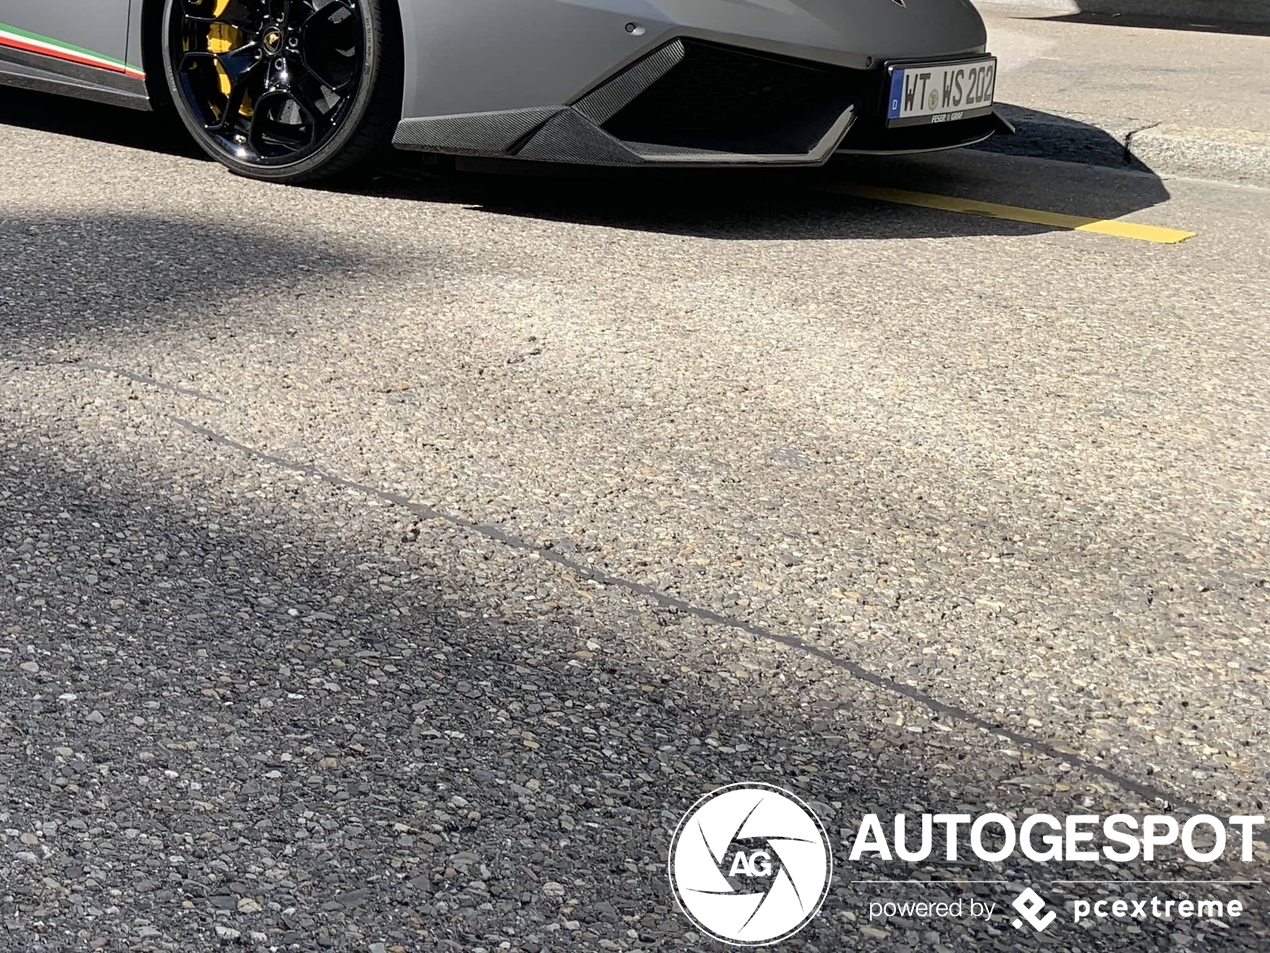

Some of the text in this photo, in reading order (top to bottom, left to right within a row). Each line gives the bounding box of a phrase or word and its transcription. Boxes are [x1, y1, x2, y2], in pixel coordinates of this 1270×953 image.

[904, 72, 932, 112] WT
[942, 69, 965, 109] WS
[965, 65, 994, 105] 202
